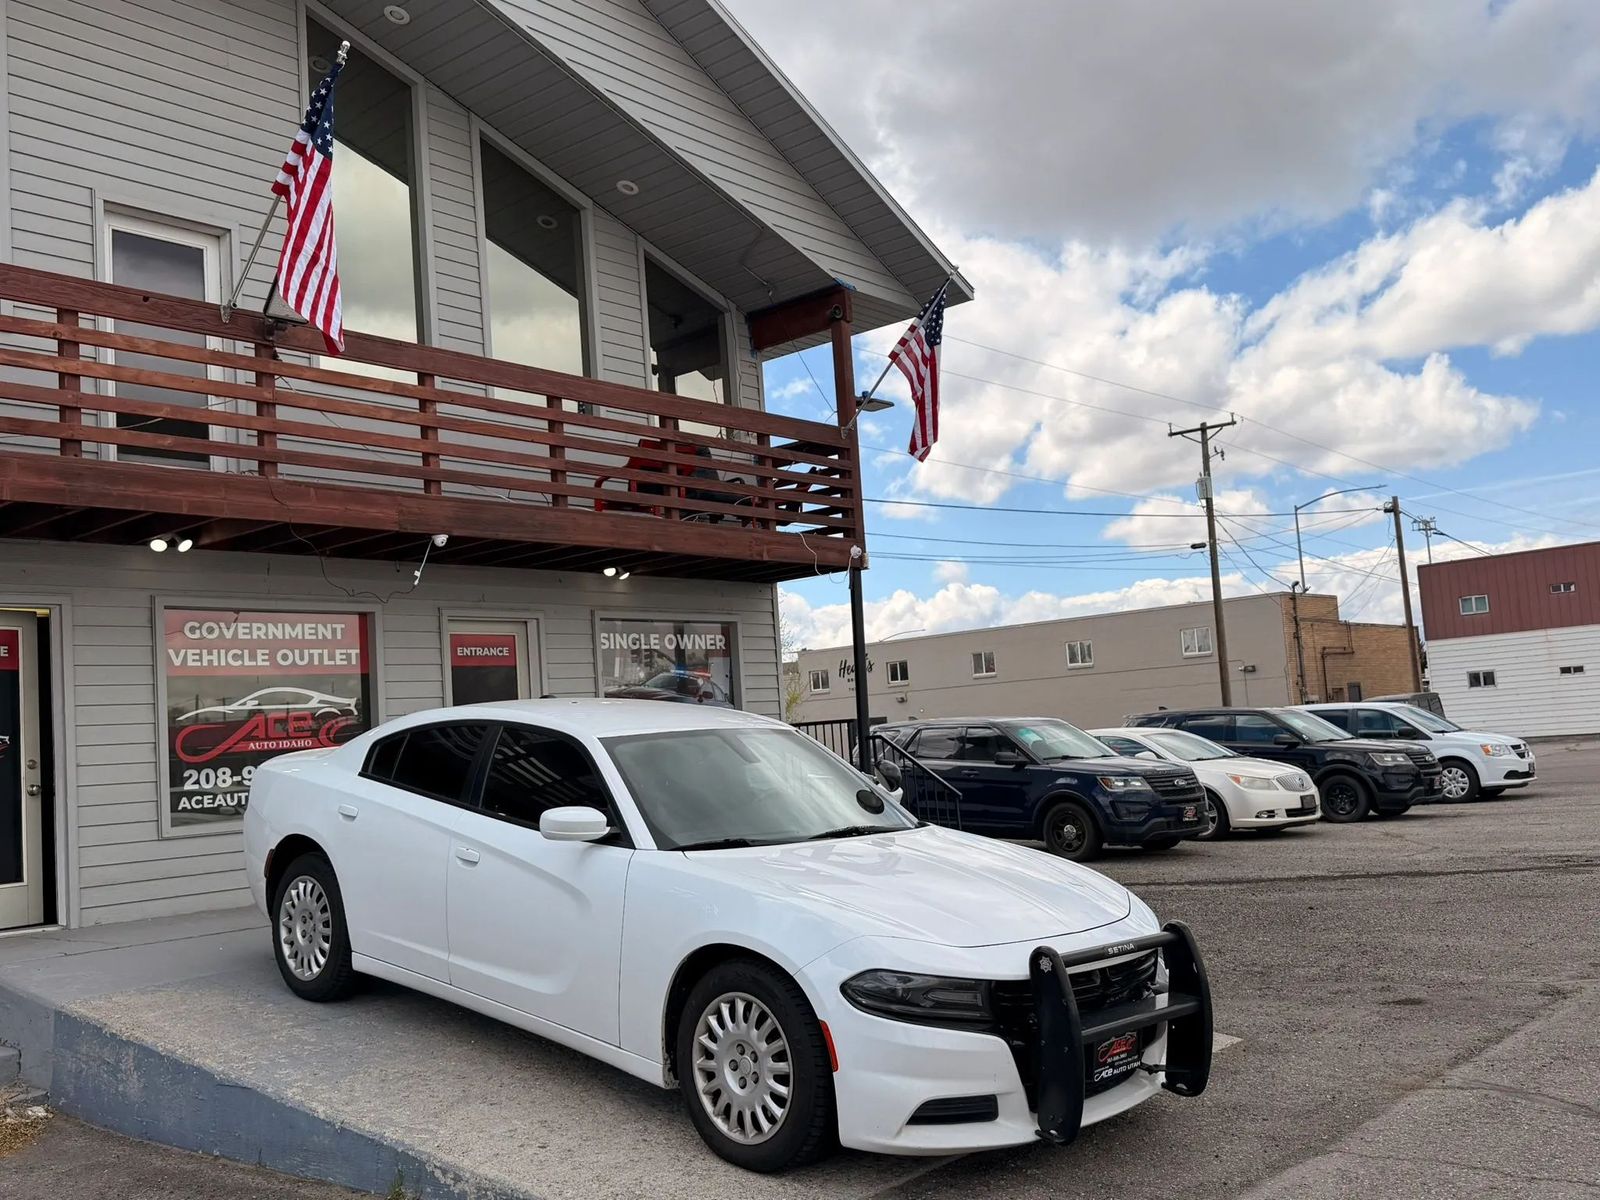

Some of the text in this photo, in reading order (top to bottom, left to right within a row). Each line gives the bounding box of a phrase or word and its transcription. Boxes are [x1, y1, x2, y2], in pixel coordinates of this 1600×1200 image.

[183, 621, 345, 640] GOVERNMENT
[600, 633, 726, 650] SINGLE OWNER
[168, 649, 360, 667] VEHICLE OUTLET
[457, 647, 509, 656] ENTRANCE
[248, 739, 312, 750] AUTO IDAHO
[1107, 943, 1135, 955] SETINA
[1113, 1066, 1127, 1075] AUTO
[1127, 1061, 1141, 1070] UTAH
